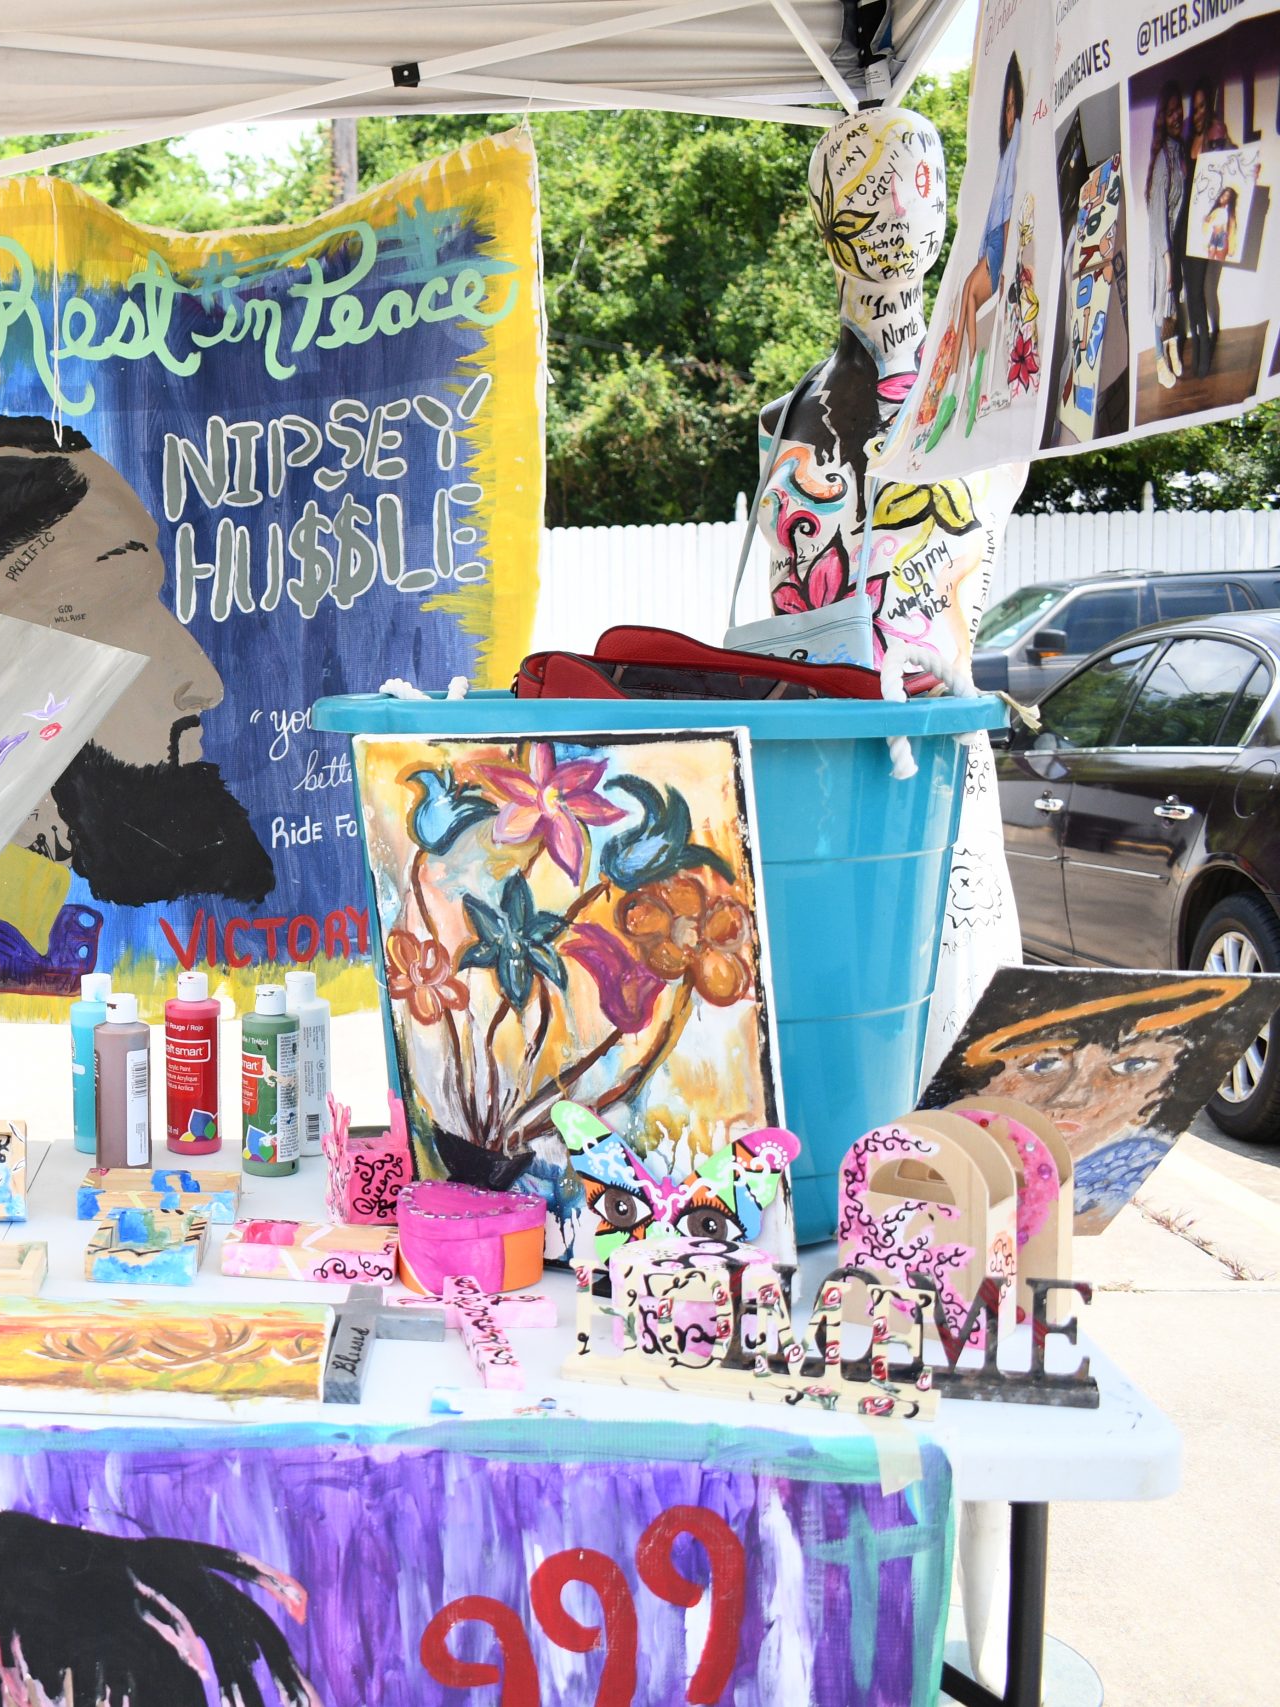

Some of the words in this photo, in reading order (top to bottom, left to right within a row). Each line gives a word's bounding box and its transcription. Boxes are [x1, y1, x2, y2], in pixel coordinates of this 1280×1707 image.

[1136, 0, 1246, 56] @THEB.SIM
[190, 275, 296, 381] in
[275, 221, 519, 353] Peace
[163, 372, 493, 523] NIPSEY
[4, 530, 57, 583] PROLIFIC
[175, 482, 487, 625] HU$$LE
[53, 615, 70, 624] WILL
[70, 612, 88, 622] RISE
[57, 604, 74, 614] GOD
[335, 813, 359, 838] Fo
[159, 905, 369, 972] VICTORY
[420, 1504, 746, 1707] 999
